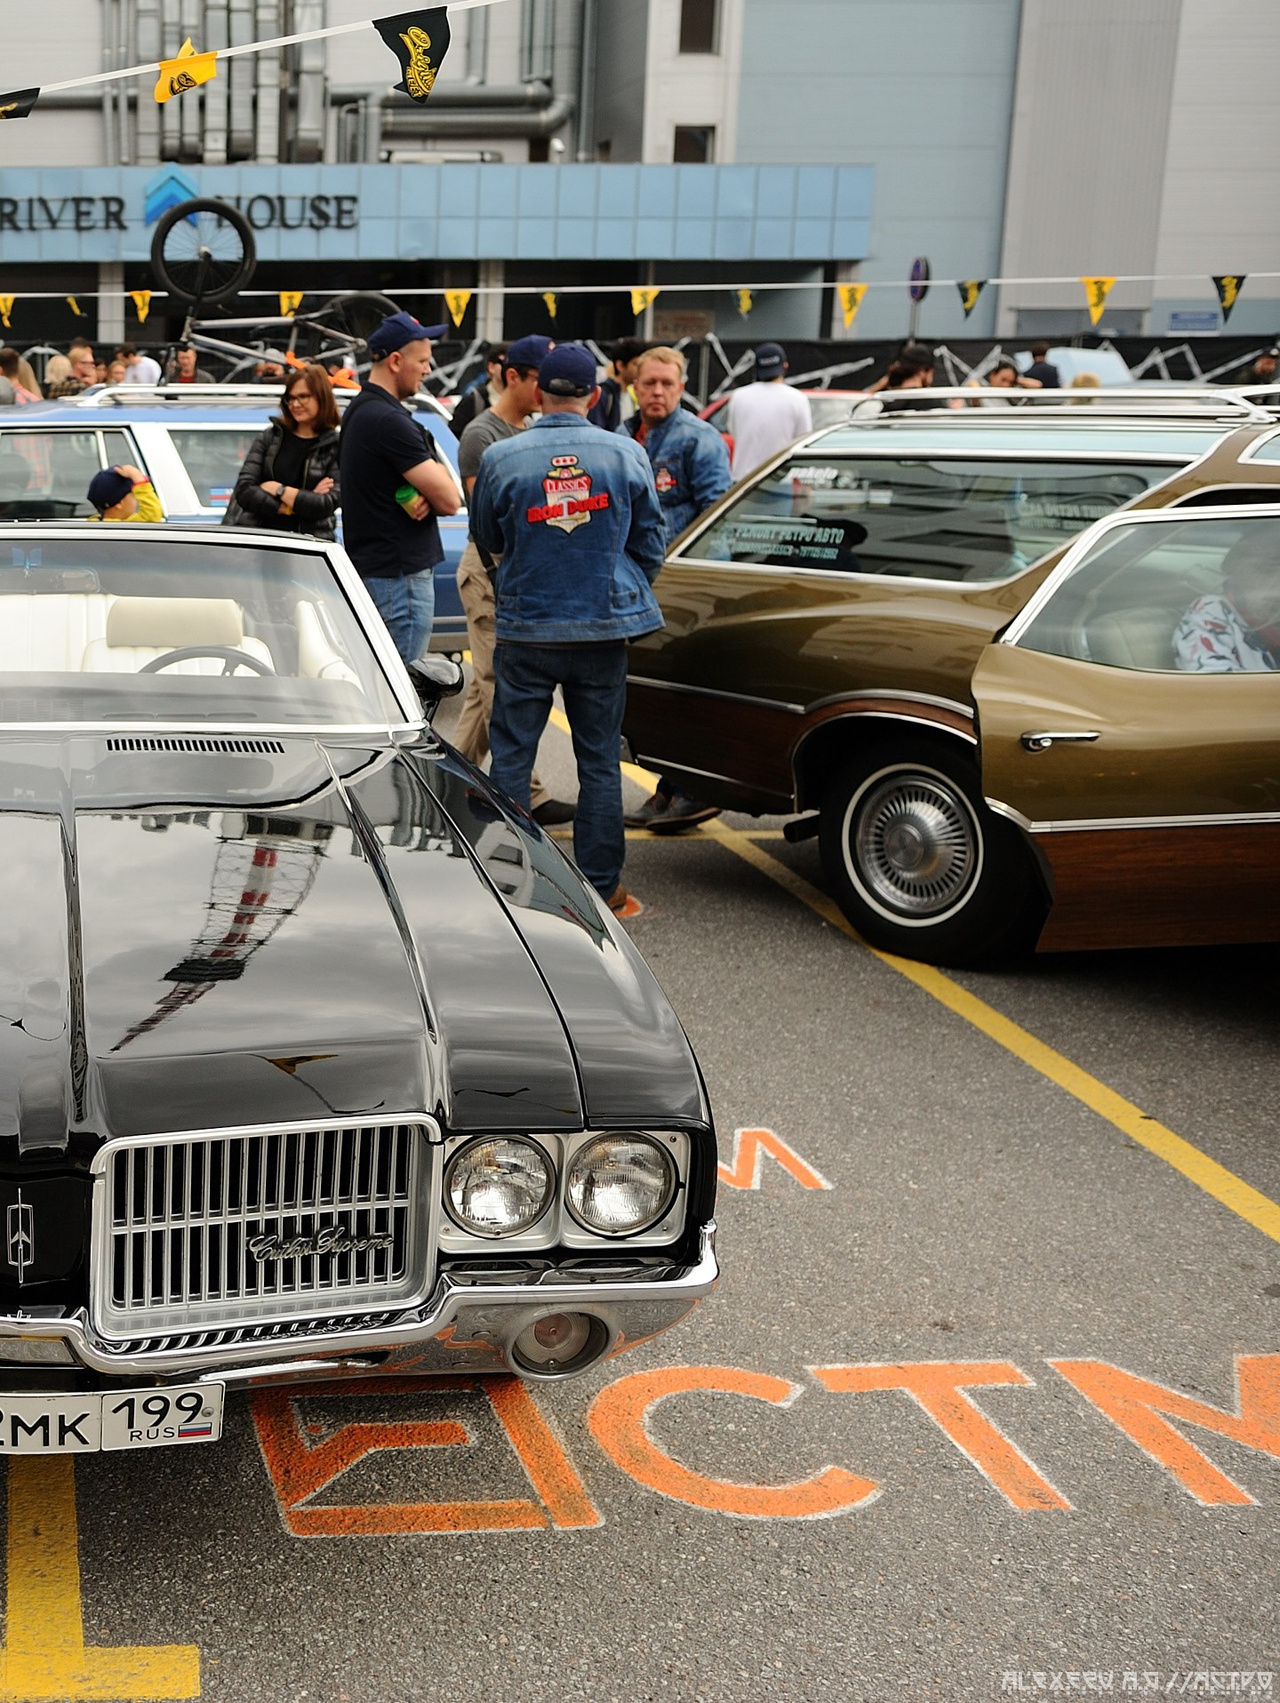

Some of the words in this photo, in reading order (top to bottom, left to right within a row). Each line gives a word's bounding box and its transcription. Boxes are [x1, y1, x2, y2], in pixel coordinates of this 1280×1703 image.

[546, 476, 589, 493] CLASSICS
[527, 503, 564, 523] IRON
[567, 493, 610, 516] DUKE
[814, 527, 845, 544] АВТО
[249, 1235, 312, 1262] Cutlass
[312, 1226, 394, 1257] Supreme
[112, 1391, 204, 1430] 199
[129, 1427, 176, 1443] RUS
